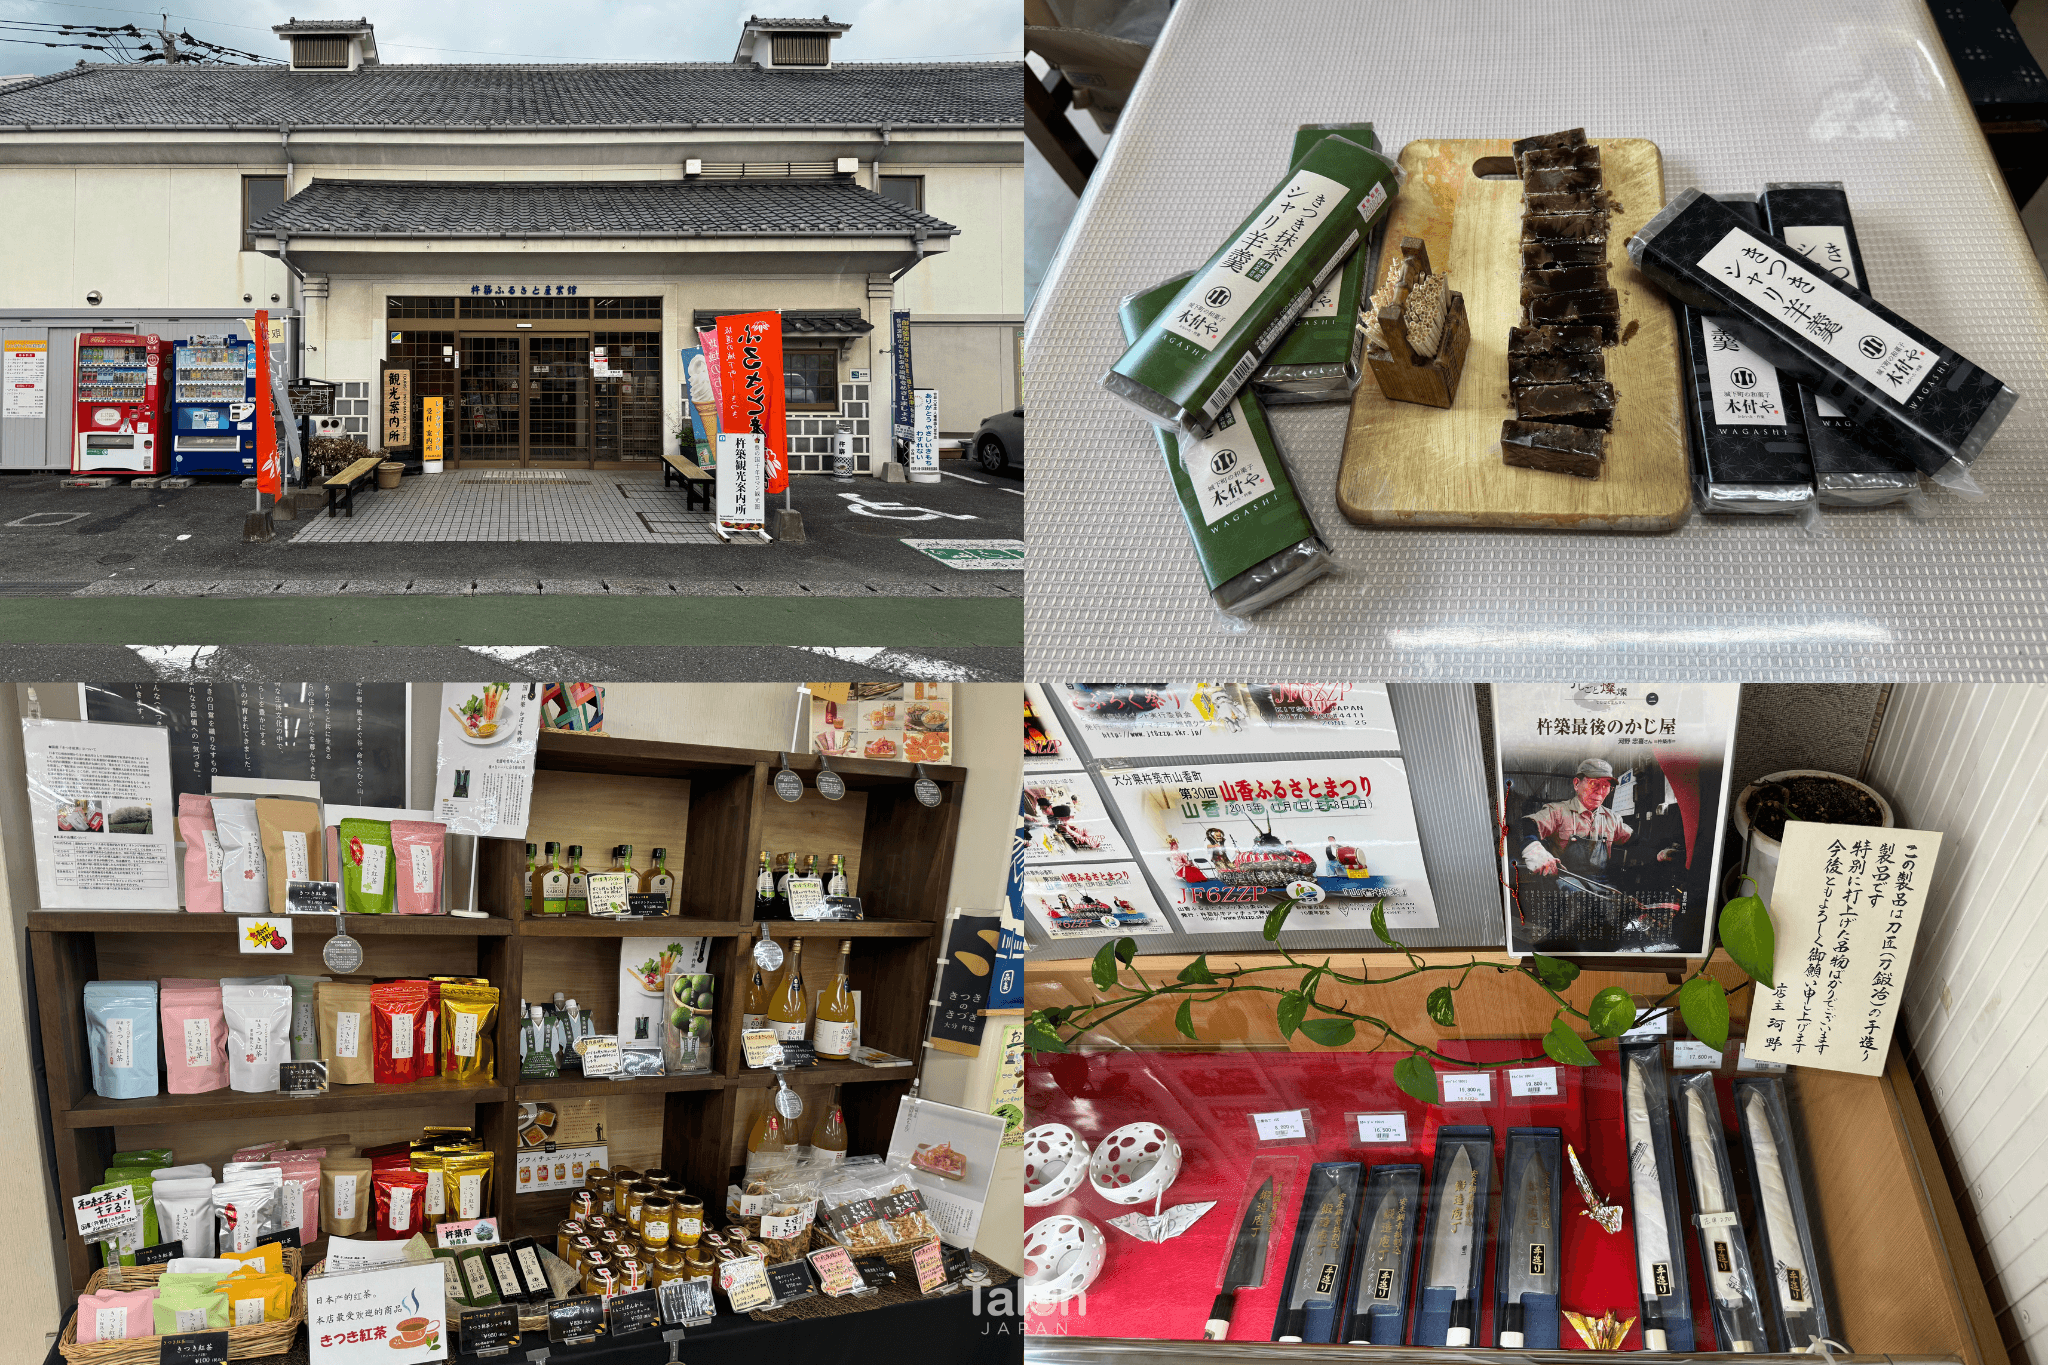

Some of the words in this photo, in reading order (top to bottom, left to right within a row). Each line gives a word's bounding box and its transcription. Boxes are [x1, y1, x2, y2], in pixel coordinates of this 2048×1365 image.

[1219, 185, 1309, 274] シャリ羊羹
[1271, 193, 1327, 262] きつき抹茶
[1741, 246, 1816, 295] きつき
[471, 285, 577, 296] 杵築ふるさと産業館
[1724, 259, 1844, 345] シャリ羊羹
[1174, 309, 1219, 337] 木付や
[1188, 302, 1227, 323] 城下町の和菓子
[1294, 318, 1336, 327] GASHI
[1160, 333, 1207, 361] AGASHI
[1875, 341, 1906, 377] 城下町の和菓子
[1885, 347, 1920, 389] 木付や
[1723, 391, 1771, 399] 城下町の和菓子
[1907, 359, 1950, 411] WAGASHI
[388, 373, 400, 442] 観光案内所
[1725, 399, 1776, 415] 木付や
[916, 431, 924, 460] わすれない
[1718, 426, 1789, 437] WAGASHI
[736, 438, 746, 515] 杵築観光案内所
[1207, 463, 1254, 492] 城下町の和菓子
[1210, 473, 1261, 508] 木付や
[1210, 494, 1279, 534] WAGASHI
[1571, 683, 1628, 697] しごと燦燦
[240, 682, 252, 772] ものが育まれてきました。
[324, 682, 332, 760] ありようと共に生きる
[1536, 717, 1677, 737] 杵築最後のかじ屋
[1112, 770, 1203, 788] 大分県杵築市山香町
[1178, 786, 1218, 801] 第30回
[1219, 774, 1373, 803] 山香ふるさとまつり
[1229, 802, 1262, 813] 2015年
[1060, 870, 1130, 883] 山香ふるさとまつり
[1867, 842, 1896, 908] 製品です
[1177, 885, 1267, 905] JF6ZZP
[1791, 838, 1847, 1055] 今後ともよろしく御願い申し上げます
[1814, 839, 1873, 1056] 特別に打上げた品物ばかりでございます
[1859, 844, 1919, 1063] この製品は刀匠(刀鍛冶)の手造り
[949, 991, 981, 1003] きつき
[1770, 982, 1789, 1012] 店主
[944, 1022, 958, 1030] 大分
[945, 1009, 978, 1023] きづき
[1764, 1017, 1787, 1052] 河野
[77, 1188, 128, 1210] 和紅茶が
[1450, 1179, 1467, 1234] 鍛造庖丁
[445, 1228, 472, 1240] 杵築市
[146, 1251, 174, 1262] きつき紅茶
[1532, 1245, 1543, 1273] 手造り
[1716, 1243, 1729, 1271] 手造り
[1318, 1266, 1335, 1292] 手造り
[1377, 1270, 1392, 1298] 手造り
[1655, 1264, 1669, 1295] 手造り
[1789, 1269, 1800, 1300] 手造り
[315, 1303, 403, 1325] 本店最受欢迎的商品
[176, 1342, 213, 1354] きつき紅茶
[320, 1325, 388, 1348] きつき紅茶
